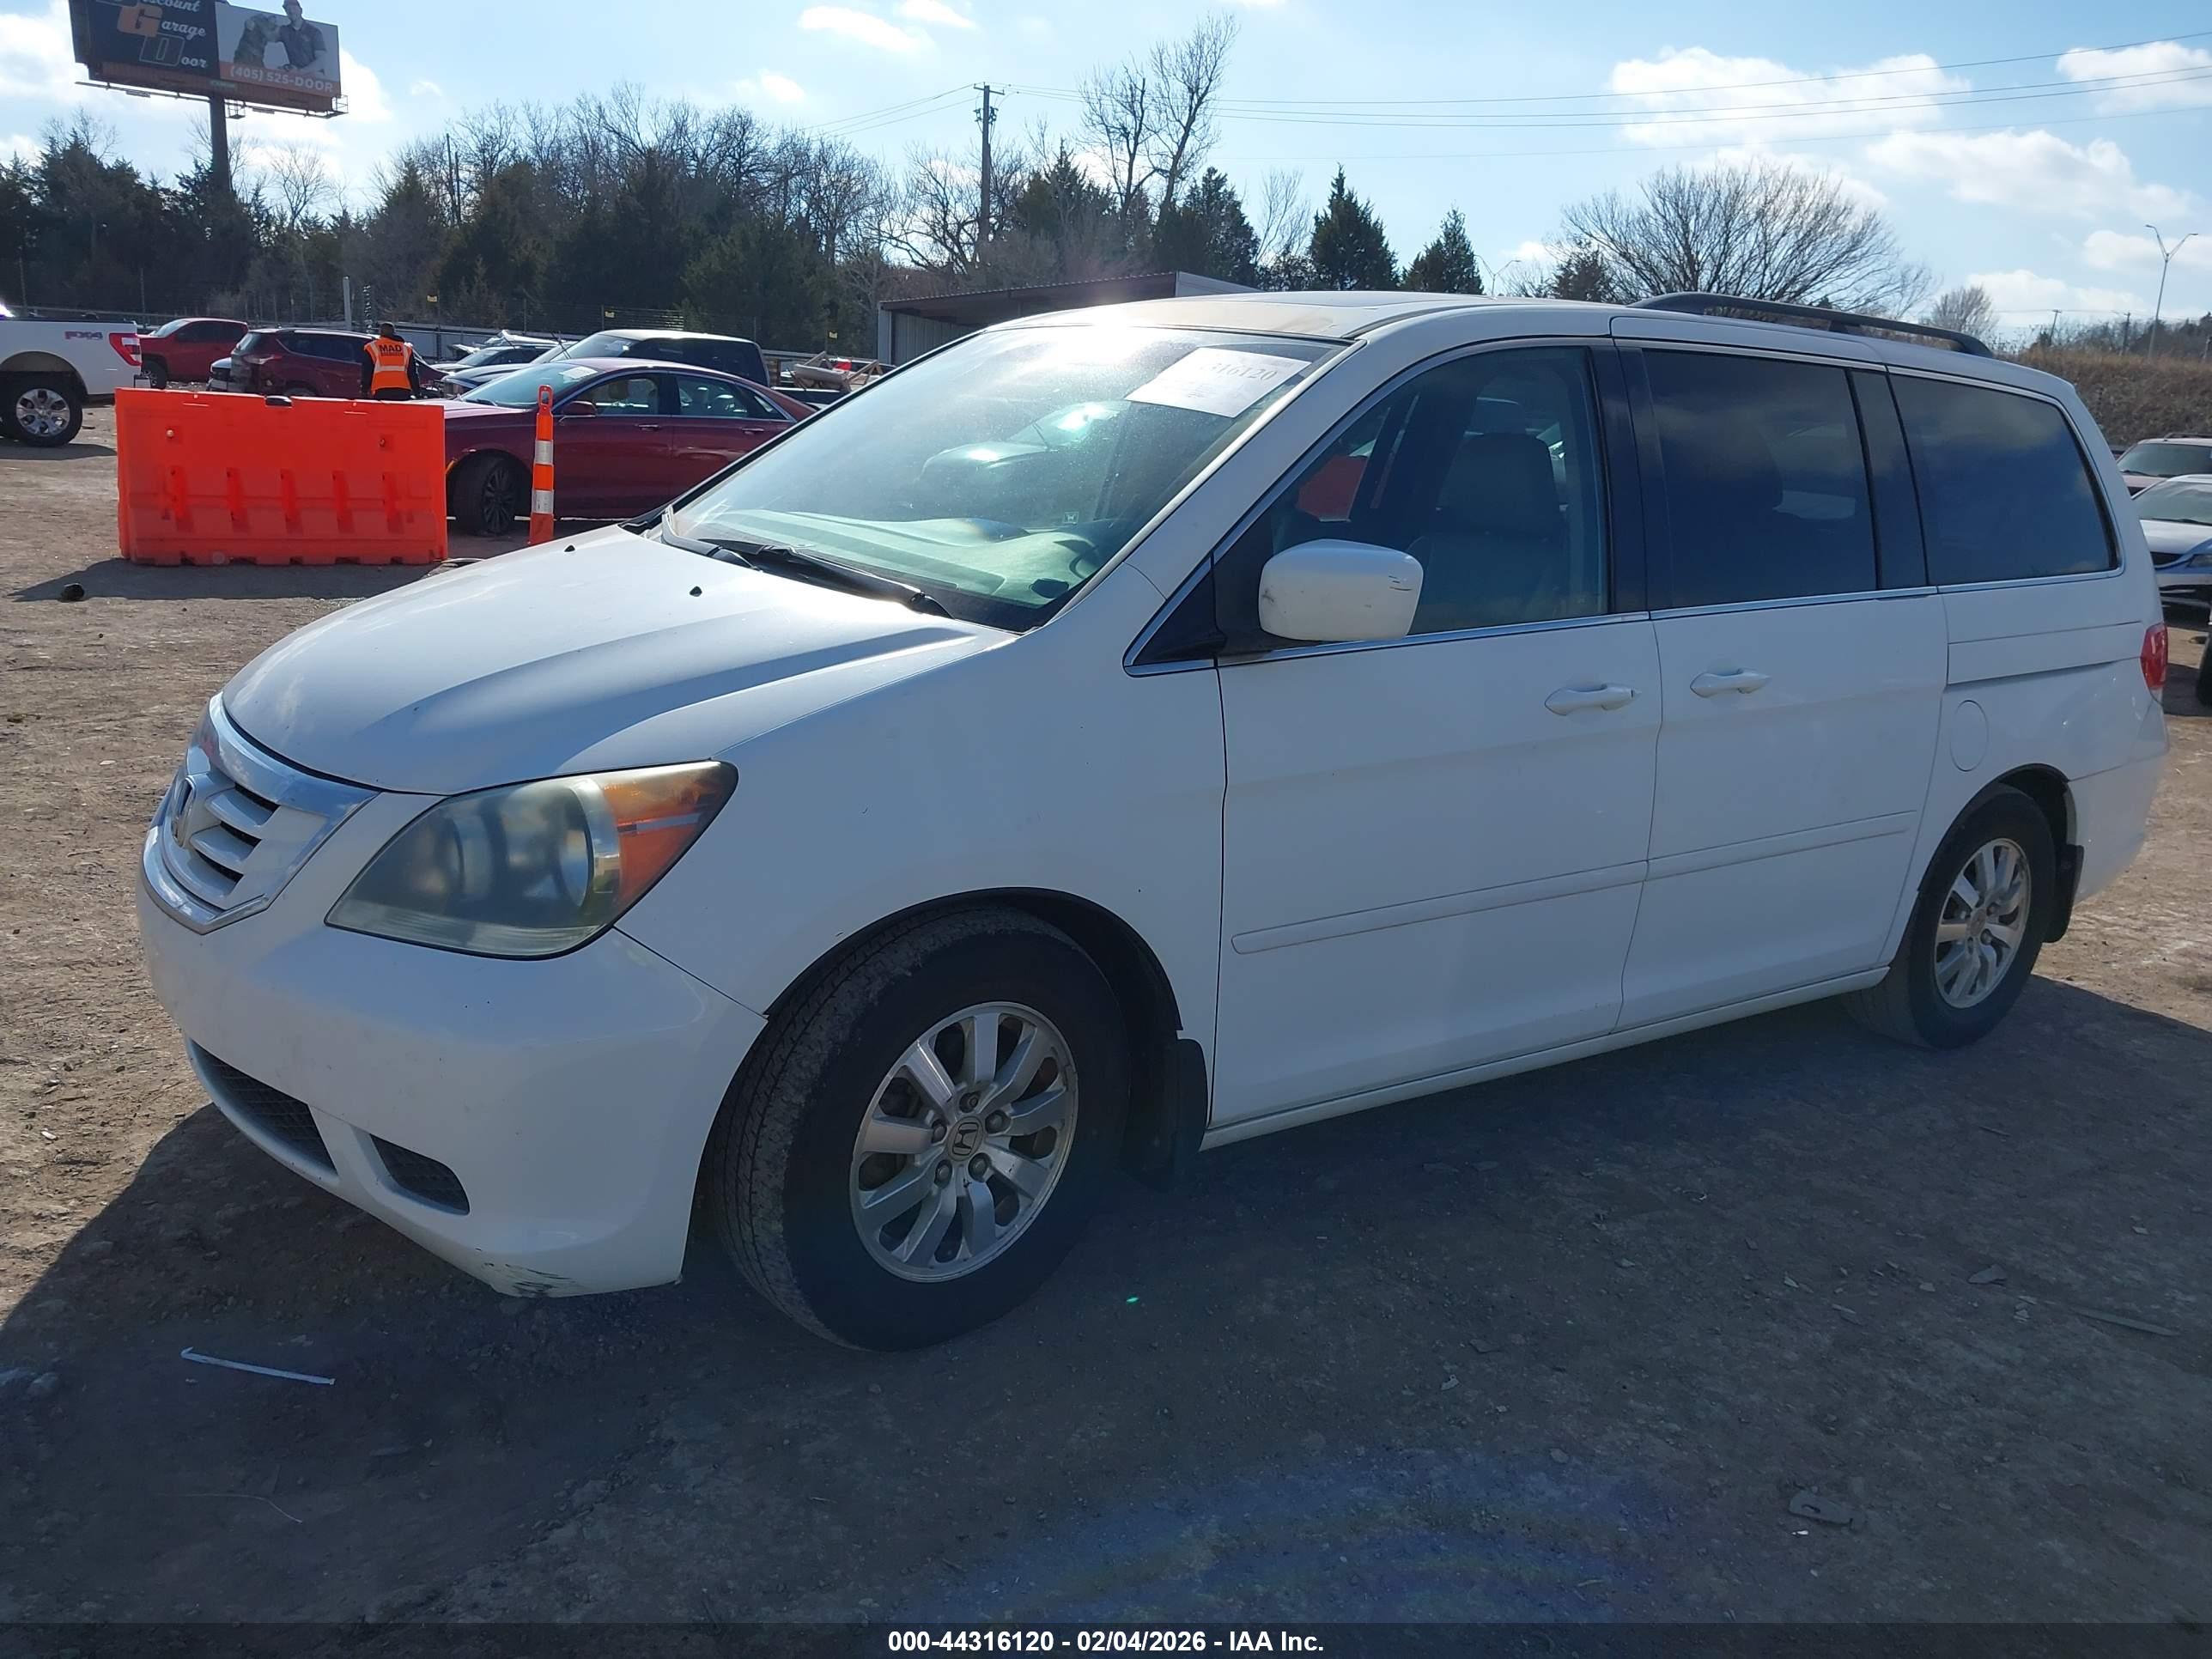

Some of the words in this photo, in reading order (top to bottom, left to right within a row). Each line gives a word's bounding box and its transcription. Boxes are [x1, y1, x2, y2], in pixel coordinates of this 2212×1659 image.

[117, 3, 207, 40] Garage
[139, 33, 208, 68] Door
[229, 66, 264, 82] (405)
[267, 71, 333, 93] 525-DOOR
[64, 331, 103, 341] FX4
